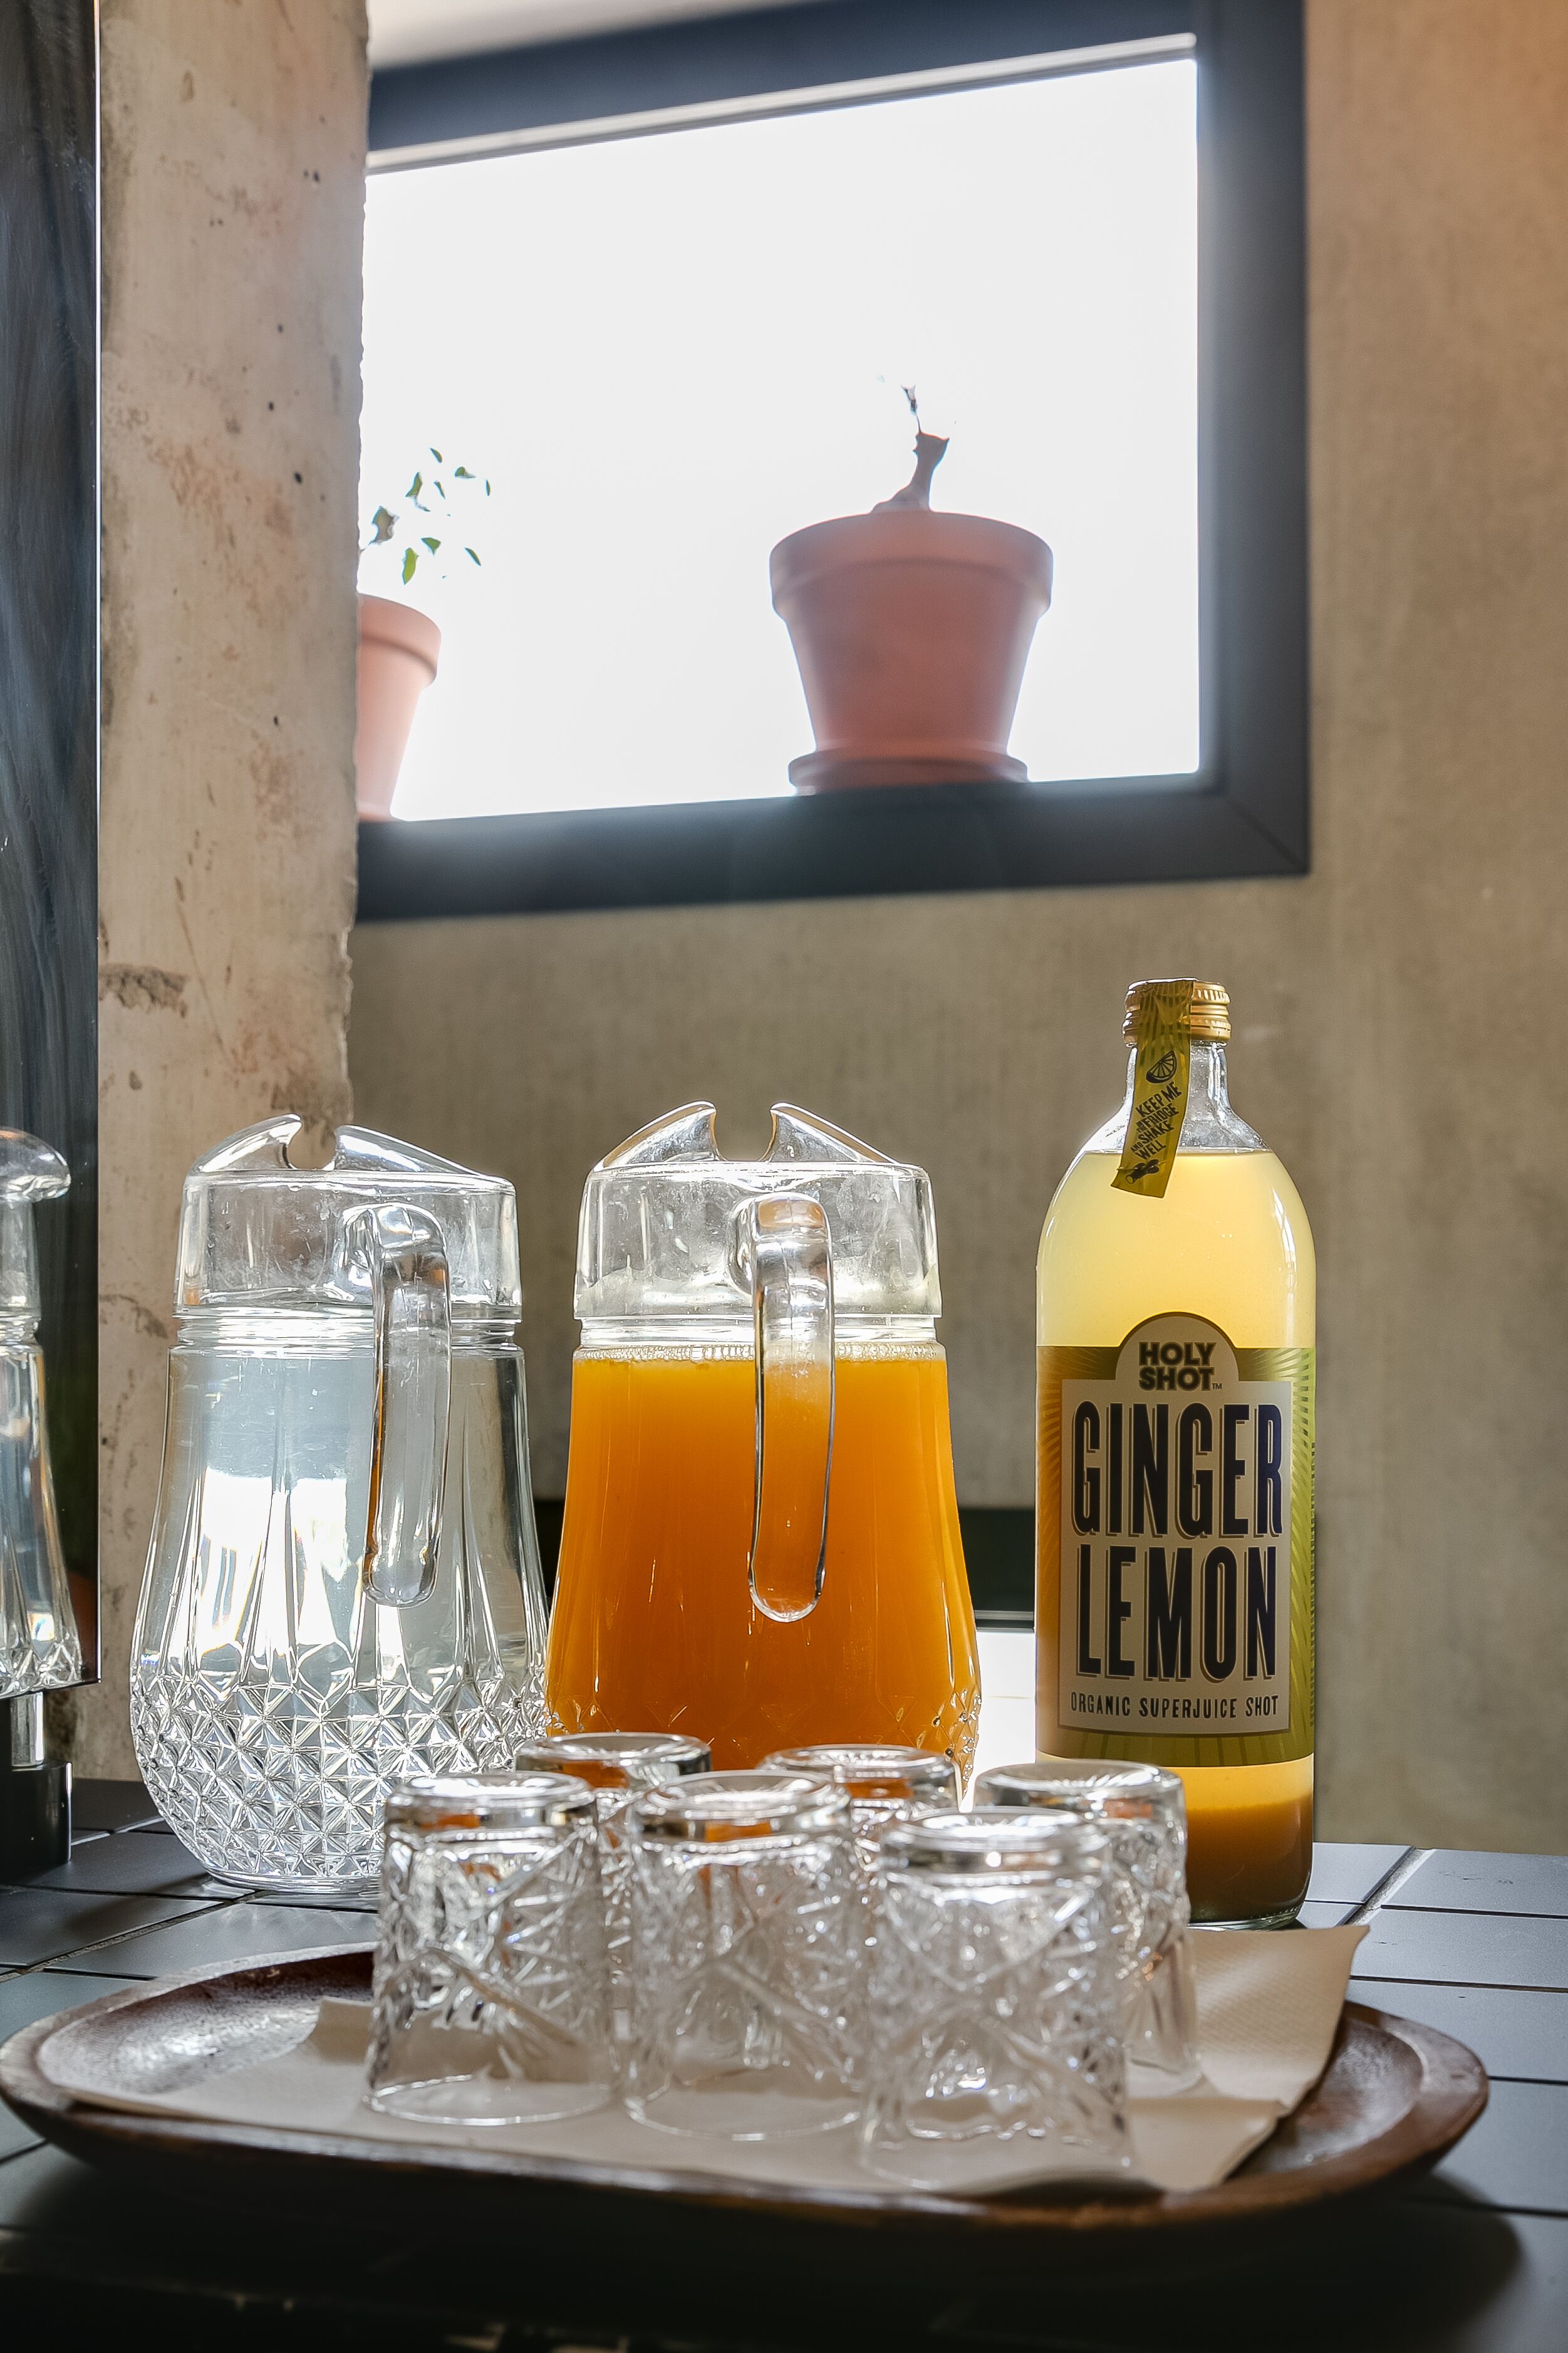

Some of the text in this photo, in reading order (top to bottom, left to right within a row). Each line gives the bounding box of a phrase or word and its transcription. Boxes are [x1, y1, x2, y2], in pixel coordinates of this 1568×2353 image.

[1135, 1081, 1182, 1117] KEEP ME
[1141, 1103, 1179, 1128] FRIDGE
[1130, 1120, 1175, 1153] AND SHAKE
[1134, 1140, 1166, 1160] WELL
[1139, 1342, 1217, 1366] HOLY
[1139, 1366, 1215, 1391] SHOT
[1071, 1400, 1283, 1540] GINGER
[1076, 1543, 1277, 1683] LEMON
[1071, 1691, 1279, 1719] ORGANIC SUPERJUICE SHOT
